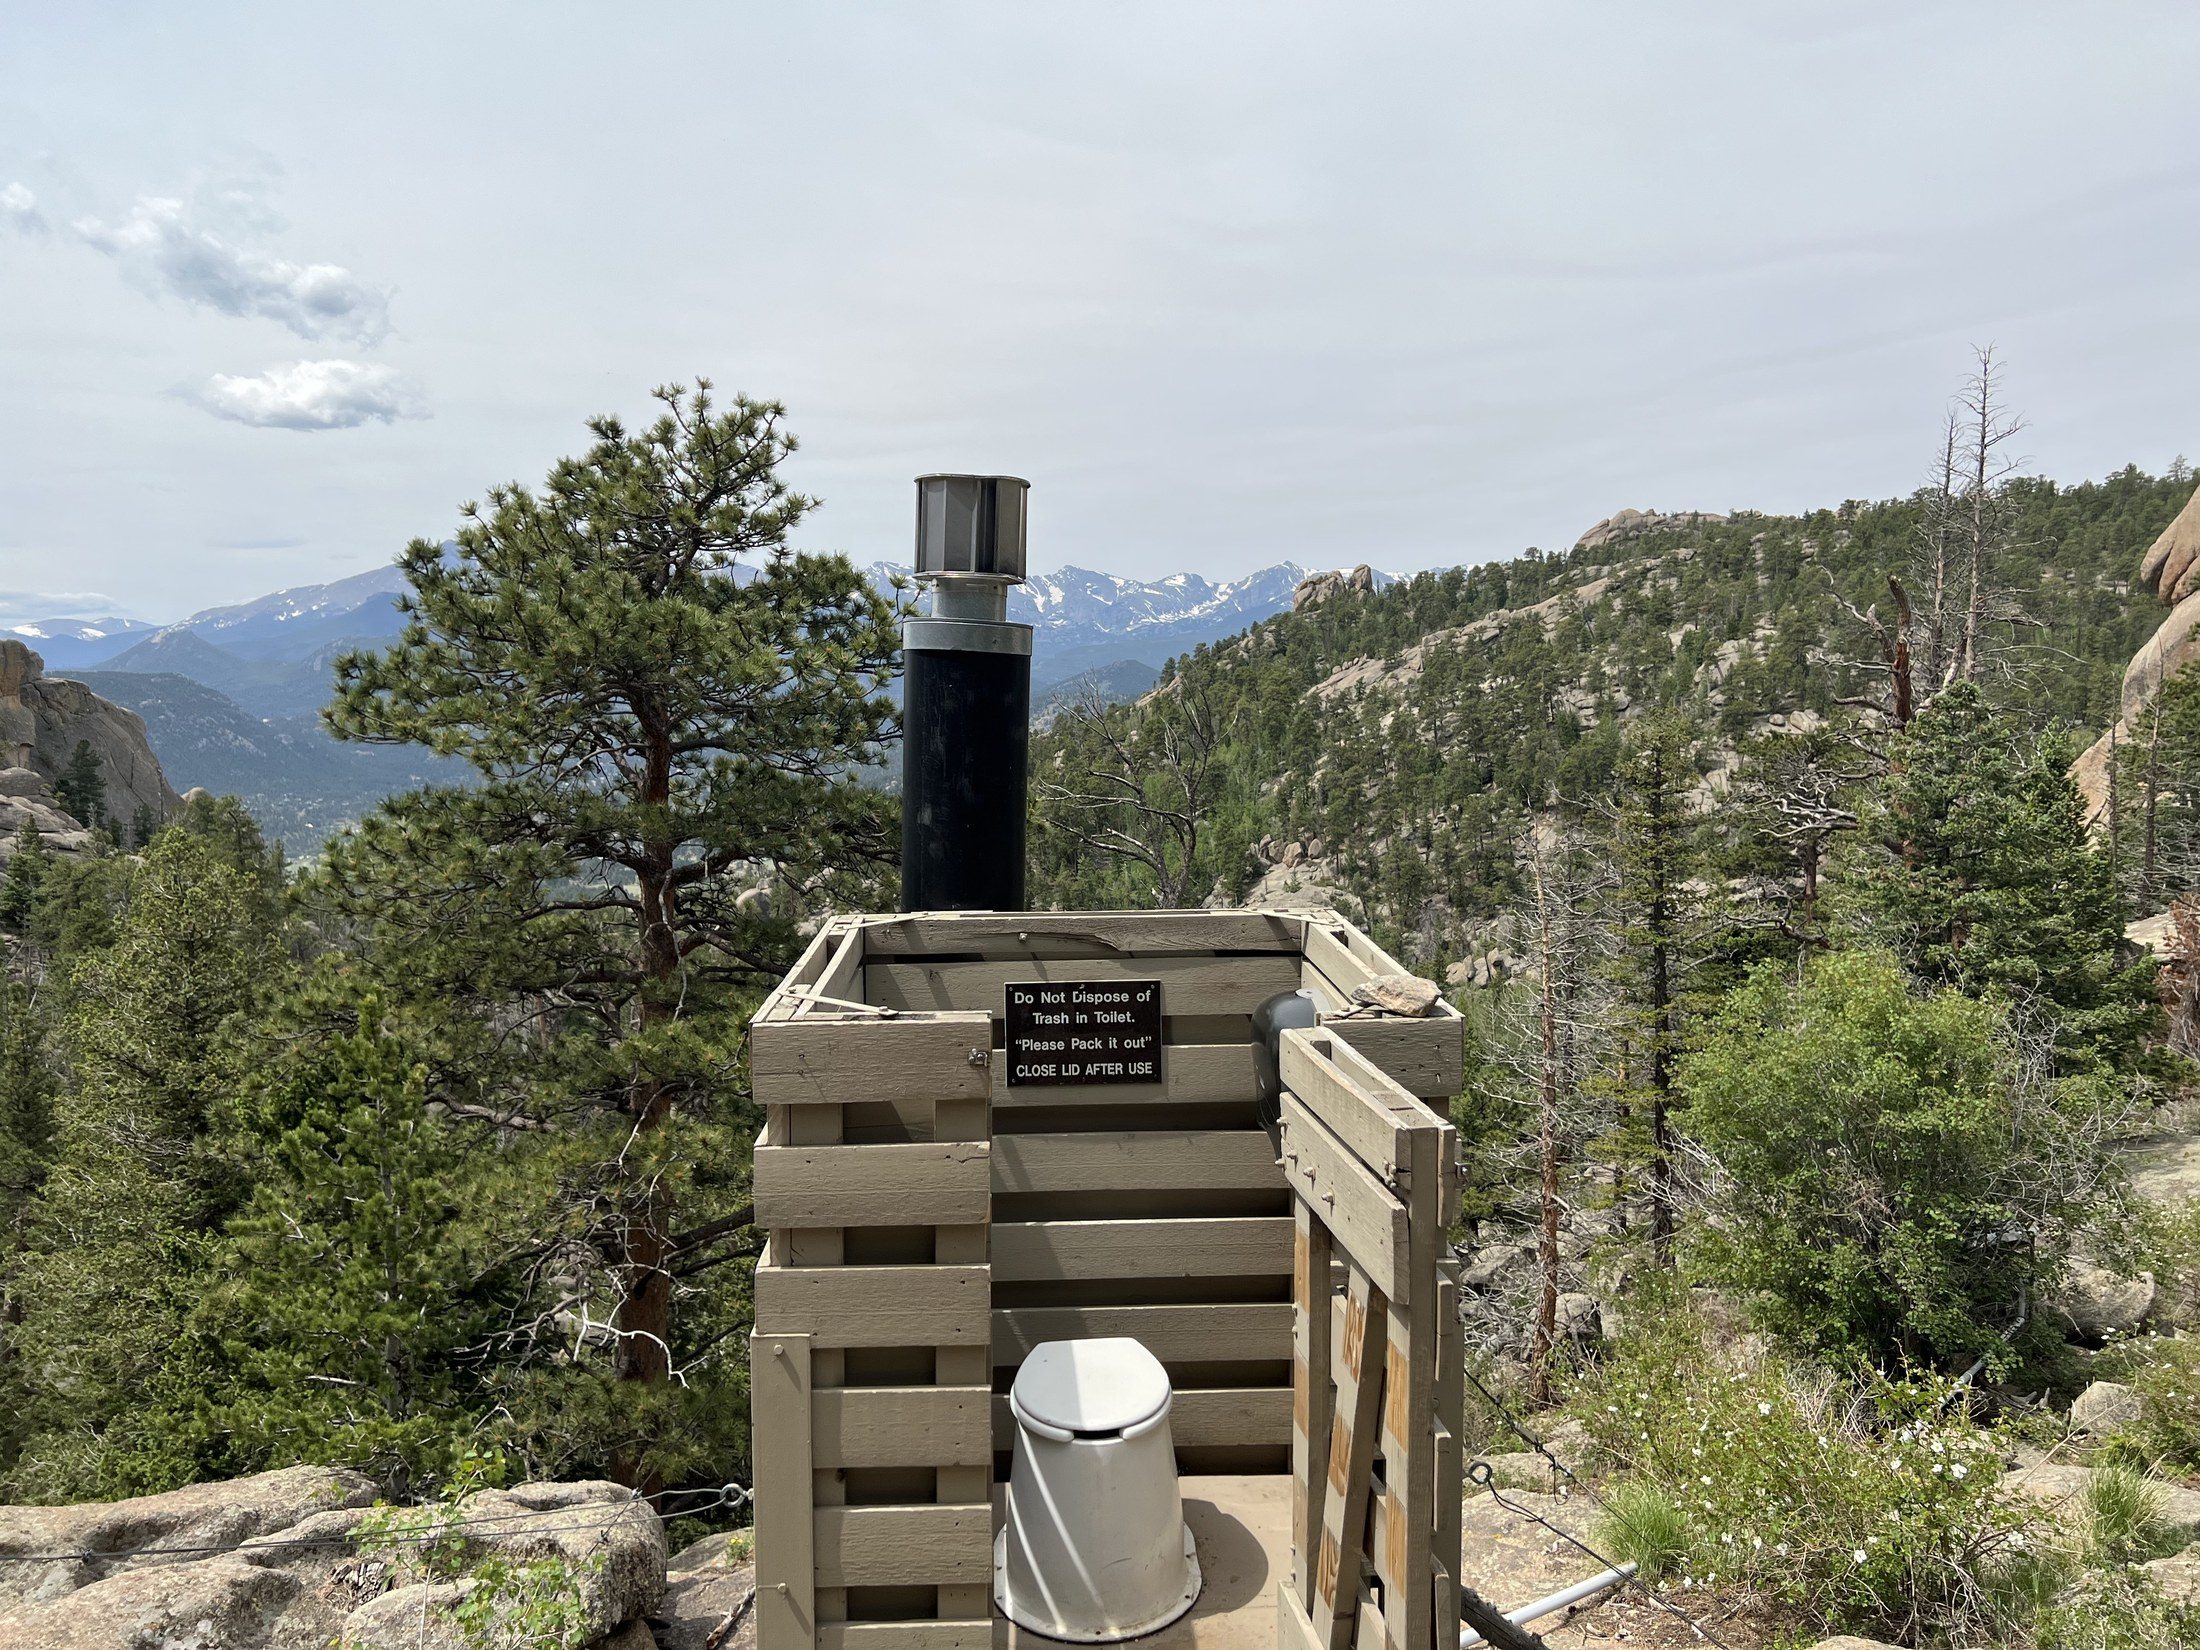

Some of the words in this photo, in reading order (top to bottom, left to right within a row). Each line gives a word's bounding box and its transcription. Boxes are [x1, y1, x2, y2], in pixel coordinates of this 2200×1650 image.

[1014, 992, 1034, 1004] Do
[1041, 991, 1065, 1003] Not
[1073, 991, 1129, 1004] Dispose
[1136, 990, 1151, 1002] of
[1033, 1012, 1069, 1024] Trash
[1076, 1012, 1088, 1023] in
[1094, 1011, 1135, 1023] Toilet.
[1015, 1039, 1065, 1051] “Please
[1071, 1038, 1102, 1049] Pack
[1108, 1037, 1117, 1049] it
[1124, 1036, 1152, 1048] out”
[1016, 1064, 1056, 1077] CLOSE
[1062, 1064, 1080, 1076] LID
[1085, 1063, 1123, 1075] AFTER
[1128, 1062, 1152, 1074] USE
